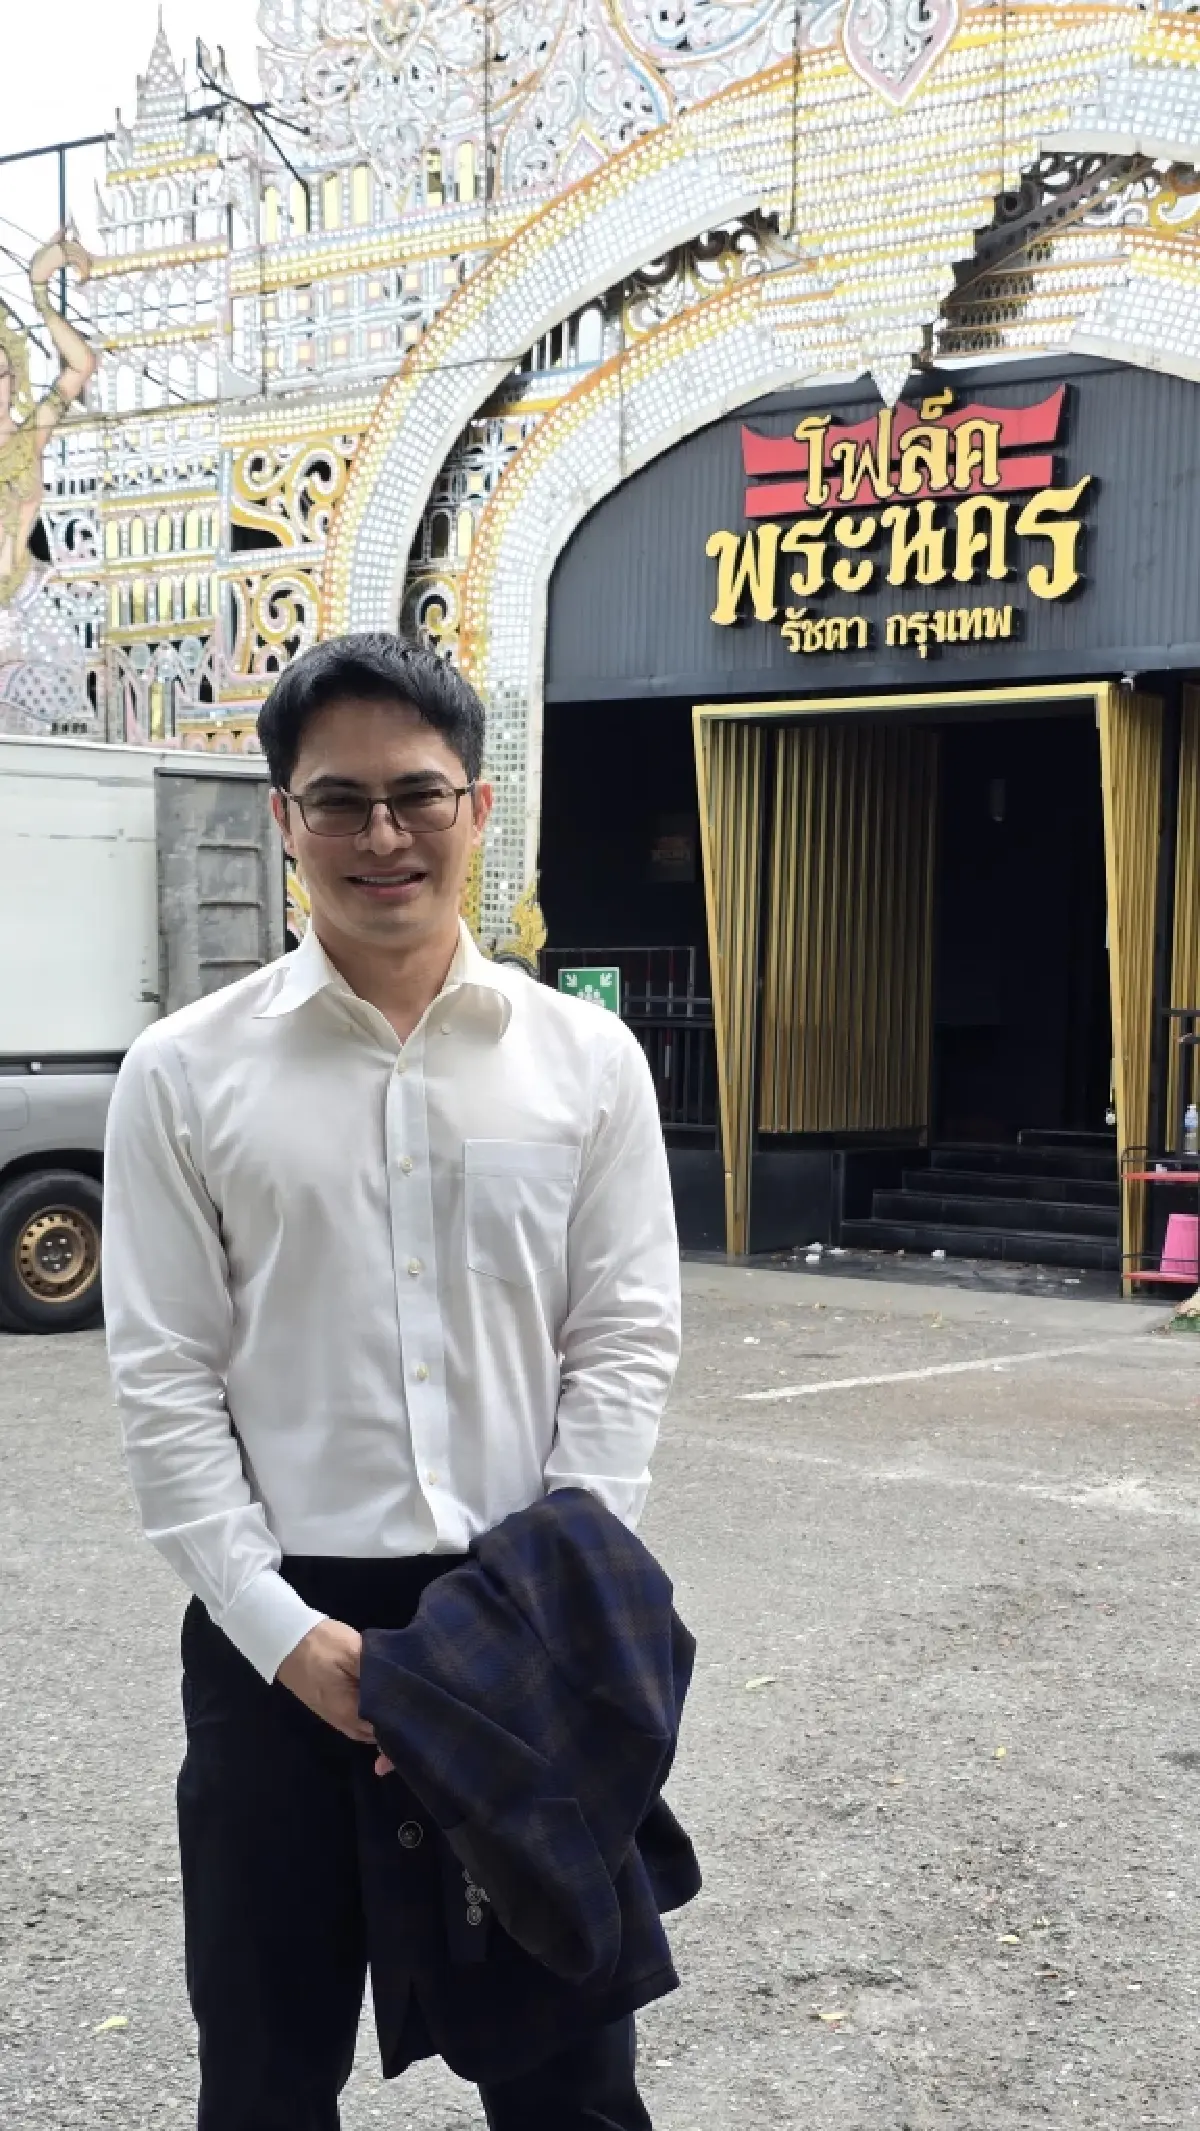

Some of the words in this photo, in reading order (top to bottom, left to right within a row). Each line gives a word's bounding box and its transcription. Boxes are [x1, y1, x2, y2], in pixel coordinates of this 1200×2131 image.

[793, 387, 1003, 506] โฟล์ค
[705, 474, 1092, 626] พระนคร
[780, 606, 869, 654] รัชดา
[886, 605, 1013, 659] กรุงเทพ
